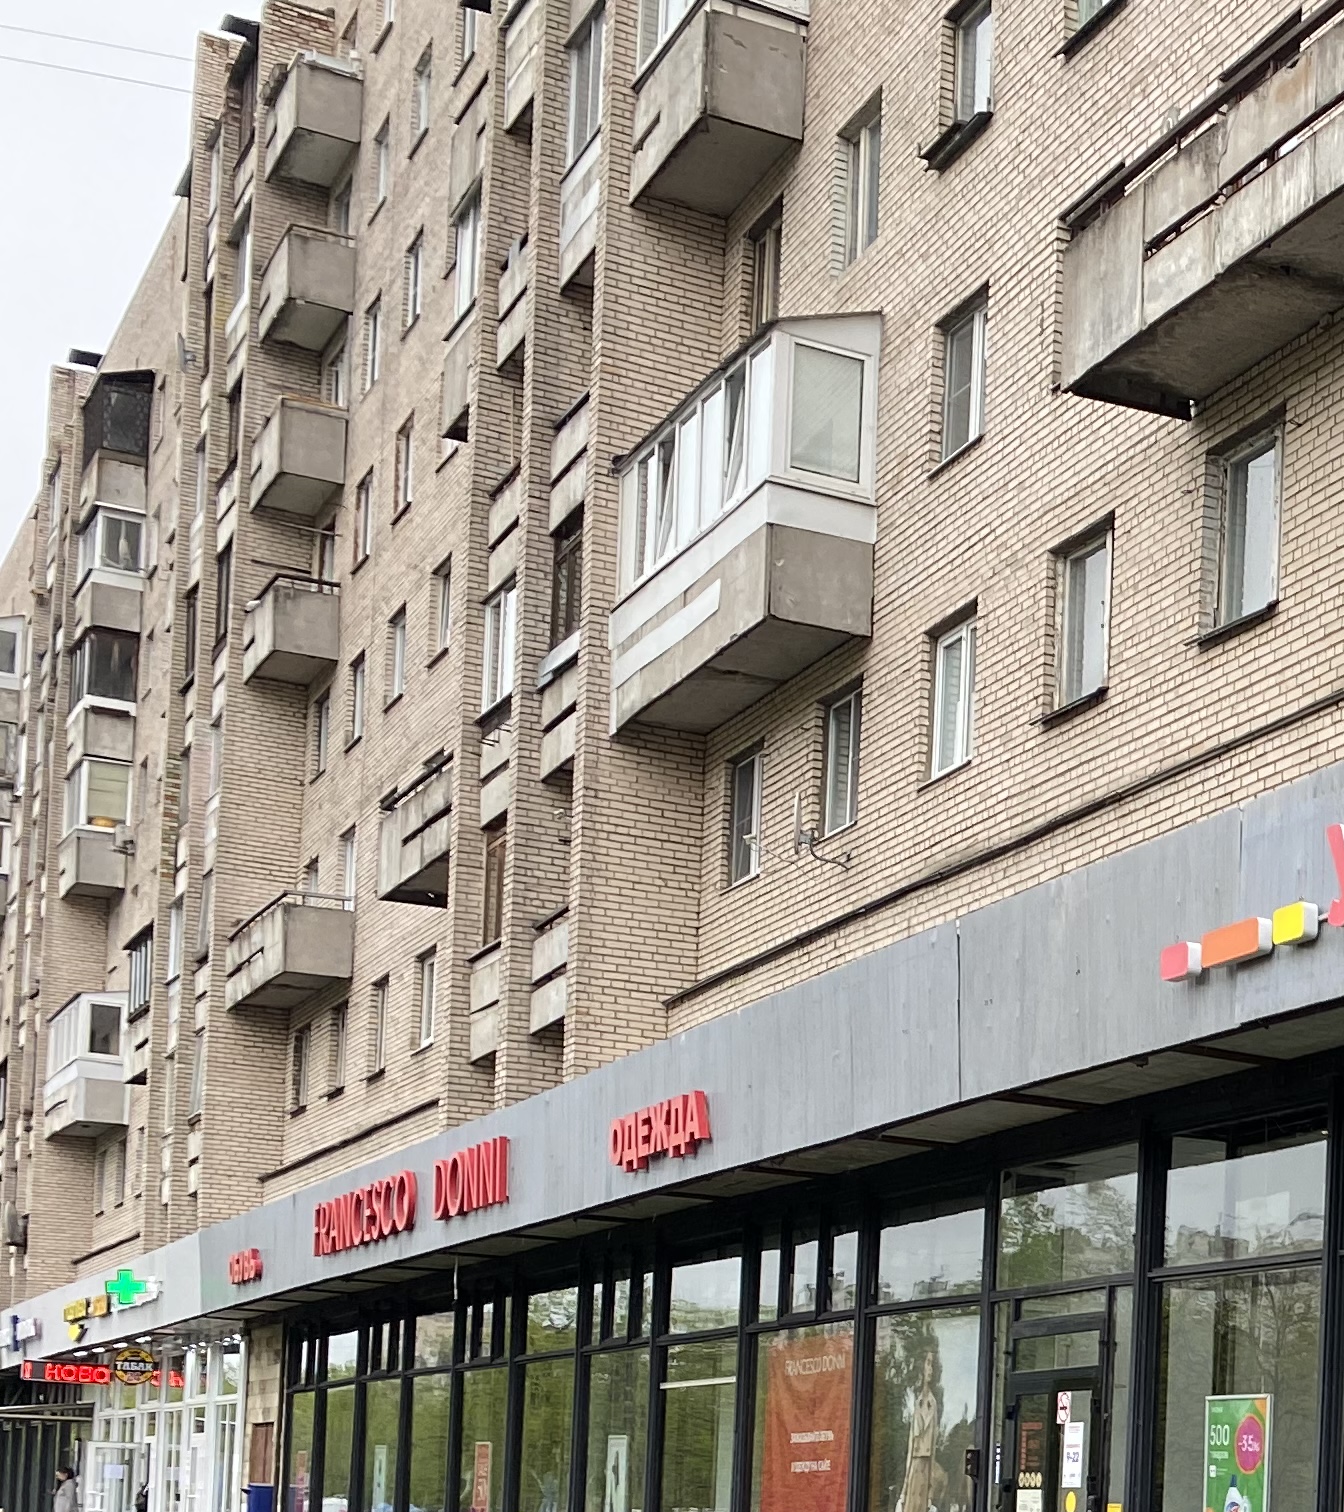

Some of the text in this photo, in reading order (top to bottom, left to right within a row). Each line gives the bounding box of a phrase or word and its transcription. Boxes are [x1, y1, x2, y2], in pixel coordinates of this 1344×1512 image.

[609, 1090, 710, 1173] ОДЕЖДА
[313, 1136, 511, 1257] FRANCESCO DONNI
[115, 1361, 153, 1371] ТАБАК
[1210, 1424, 1230, 1446] 500
